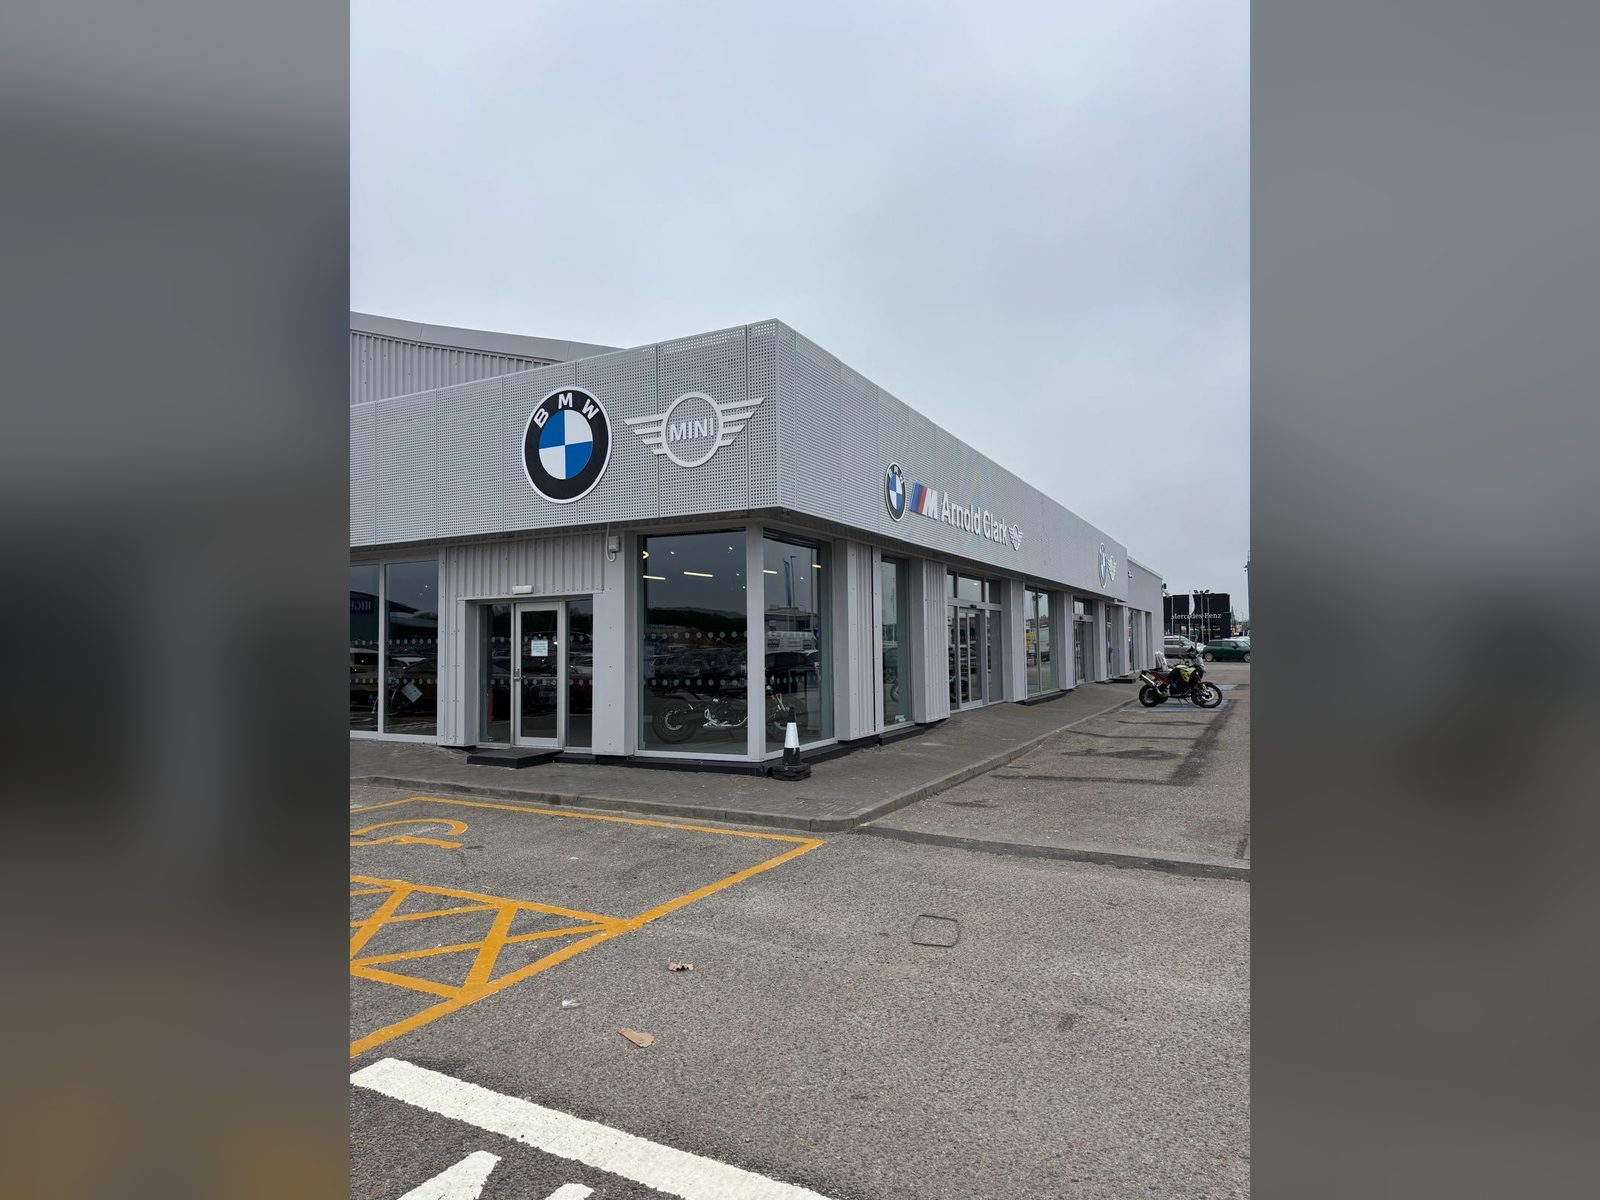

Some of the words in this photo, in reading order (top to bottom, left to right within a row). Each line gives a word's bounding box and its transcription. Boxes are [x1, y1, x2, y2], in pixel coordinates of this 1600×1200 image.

[533, 392, 600, 429] BMW
[669, 418, 714, 442] MINI
[941, 490, 980, 535] Arnold
[983, 510, 1008, 545] Clark
